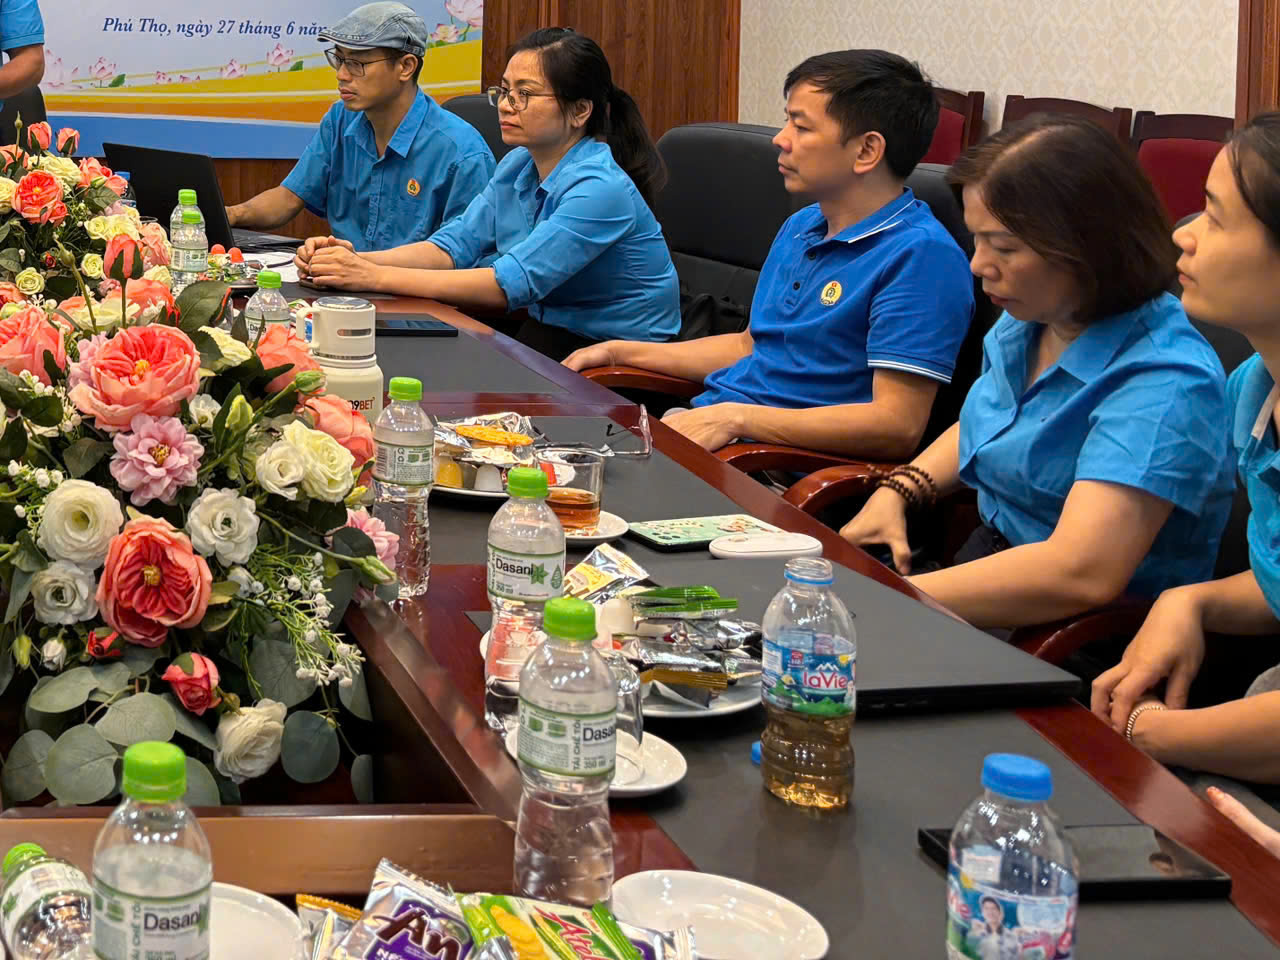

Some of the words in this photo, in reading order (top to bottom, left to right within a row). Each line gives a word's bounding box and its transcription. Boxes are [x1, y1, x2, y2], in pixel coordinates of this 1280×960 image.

[102, 17, 133, 33] Phú
[138, 18, 172, 37] Thọ,
[176, 19, 213, 38] ngày
[217, 20, 236, 34] 27
[239, 20, 282, 40] tháng
[286, 21, 296, 35] 6
[495, 557, 534, 576] Dasani
[803, 670, 849, 689] laVie
[582, 724, 616, 742] Dasa
